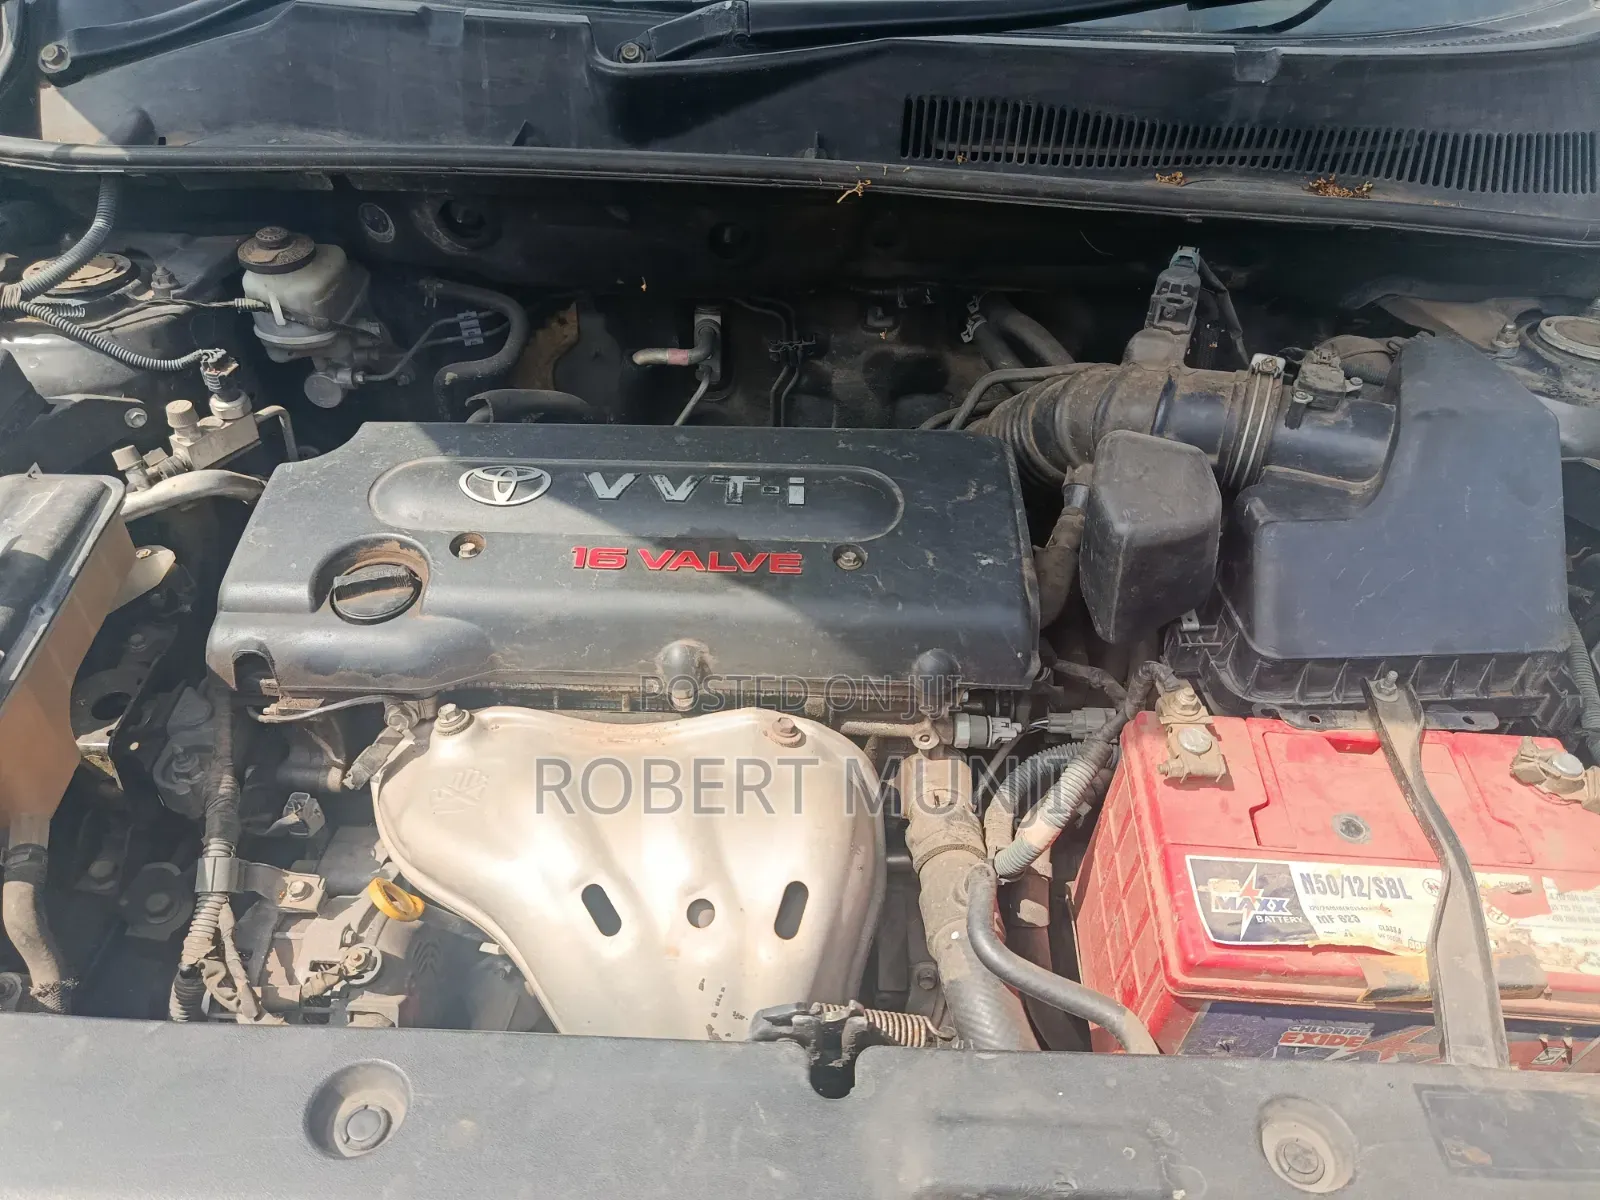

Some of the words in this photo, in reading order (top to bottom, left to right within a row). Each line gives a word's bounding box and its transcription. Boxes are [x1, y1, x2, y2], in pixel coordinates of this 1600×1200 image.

[571, 546, 629, 571] 16
[637, 549, 804, 574] VALVE
[1299, 872, 1413, 900] N50/12/SBL
[1213, 895, 1291, 914] MAXX
[1255, 915, 1304, 925] BATTERY
[1288, 1025, 1372, 1037] CHLORIDE
[1279, 1032, 1368, 1048] EXIDE
